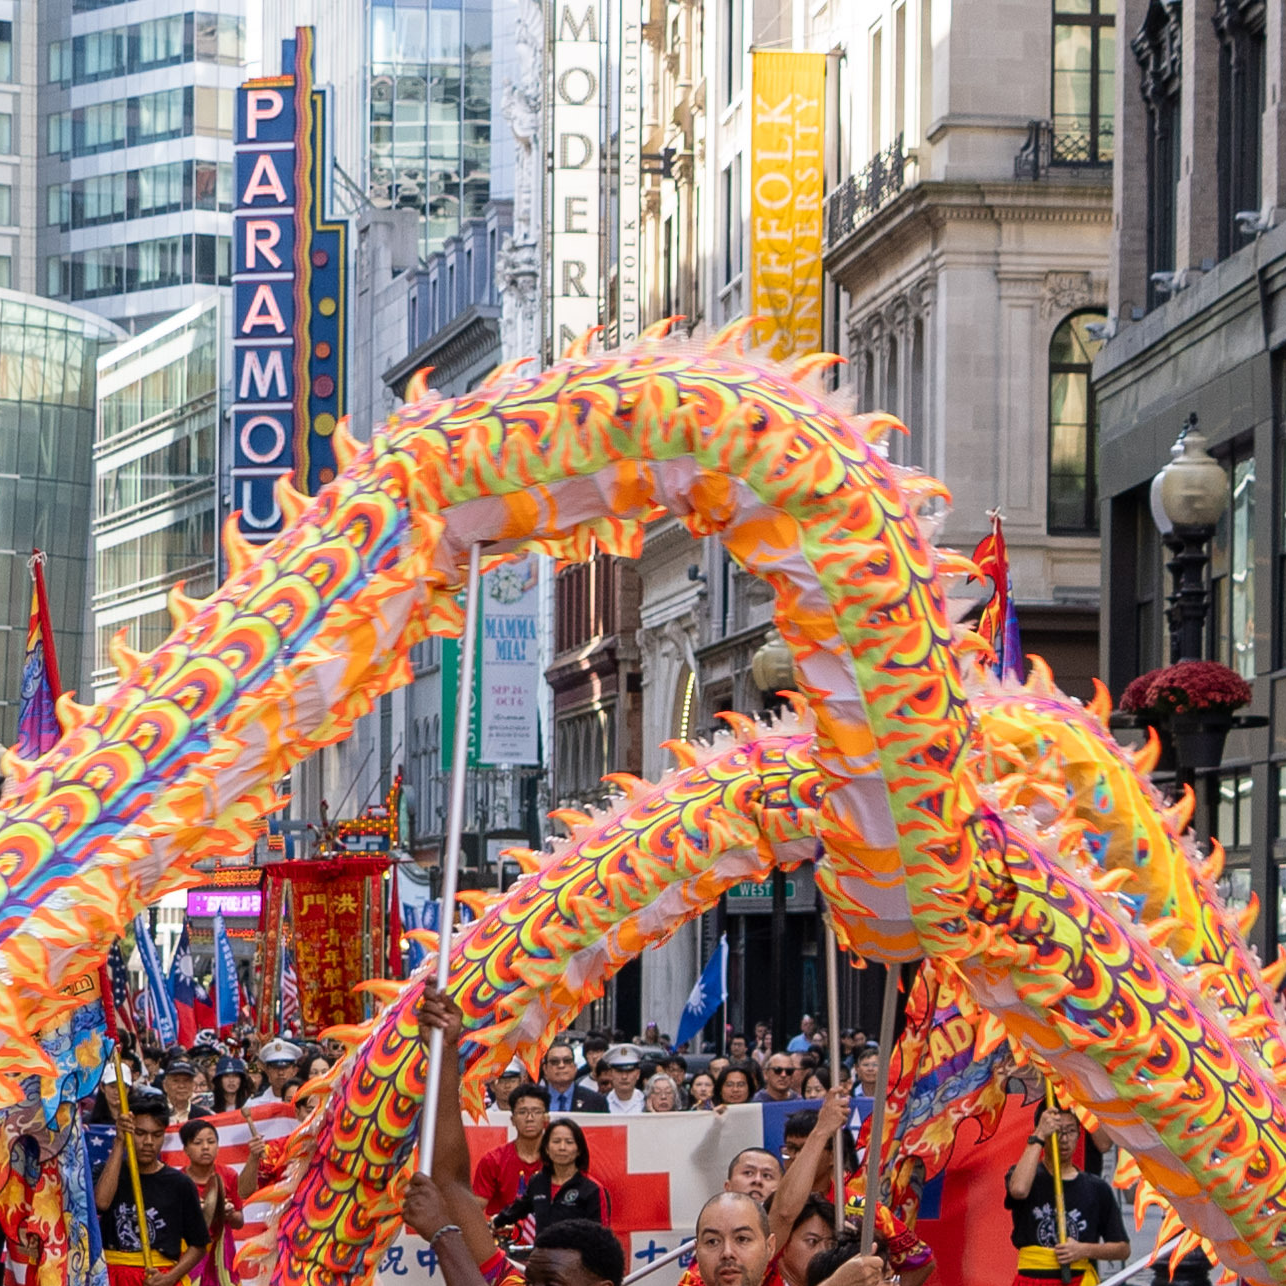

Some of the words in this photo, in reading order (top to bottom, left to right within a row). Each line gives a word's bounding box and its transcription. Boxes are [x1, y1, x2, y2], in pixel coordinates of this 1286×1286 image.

[623, 22, 637, 187] UNIVERSITY
[623, 219, 636, 348] SUFFOLK
[755, 92, 794, 356] SUFFOLK
[794, 93, 820, 352] UNIVERSITY
[484, 617, 537, 639] MAMMA
[496, 639, 526, 661] MIA!
[740, 883, 772, 896] WEST
